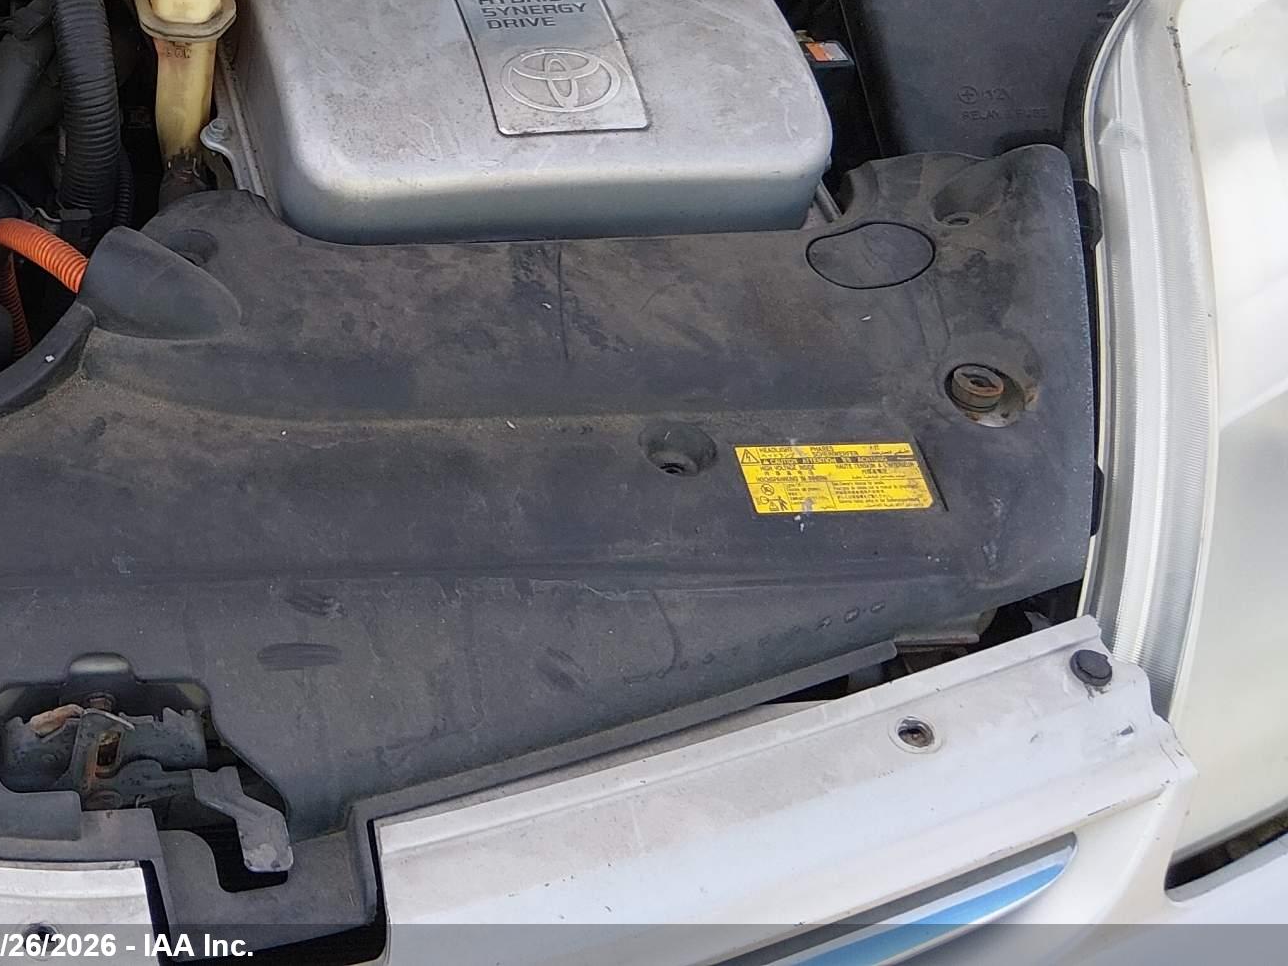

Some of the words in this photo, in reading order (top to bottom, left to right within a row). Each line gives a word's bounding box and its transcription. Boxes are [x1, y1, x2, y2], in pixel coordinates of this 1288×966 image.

[480, 2, 587, 18] SYNERGY
[486, 17, 557, 29] DRIVE
[802, 457, 836, 465] ATTENTION
